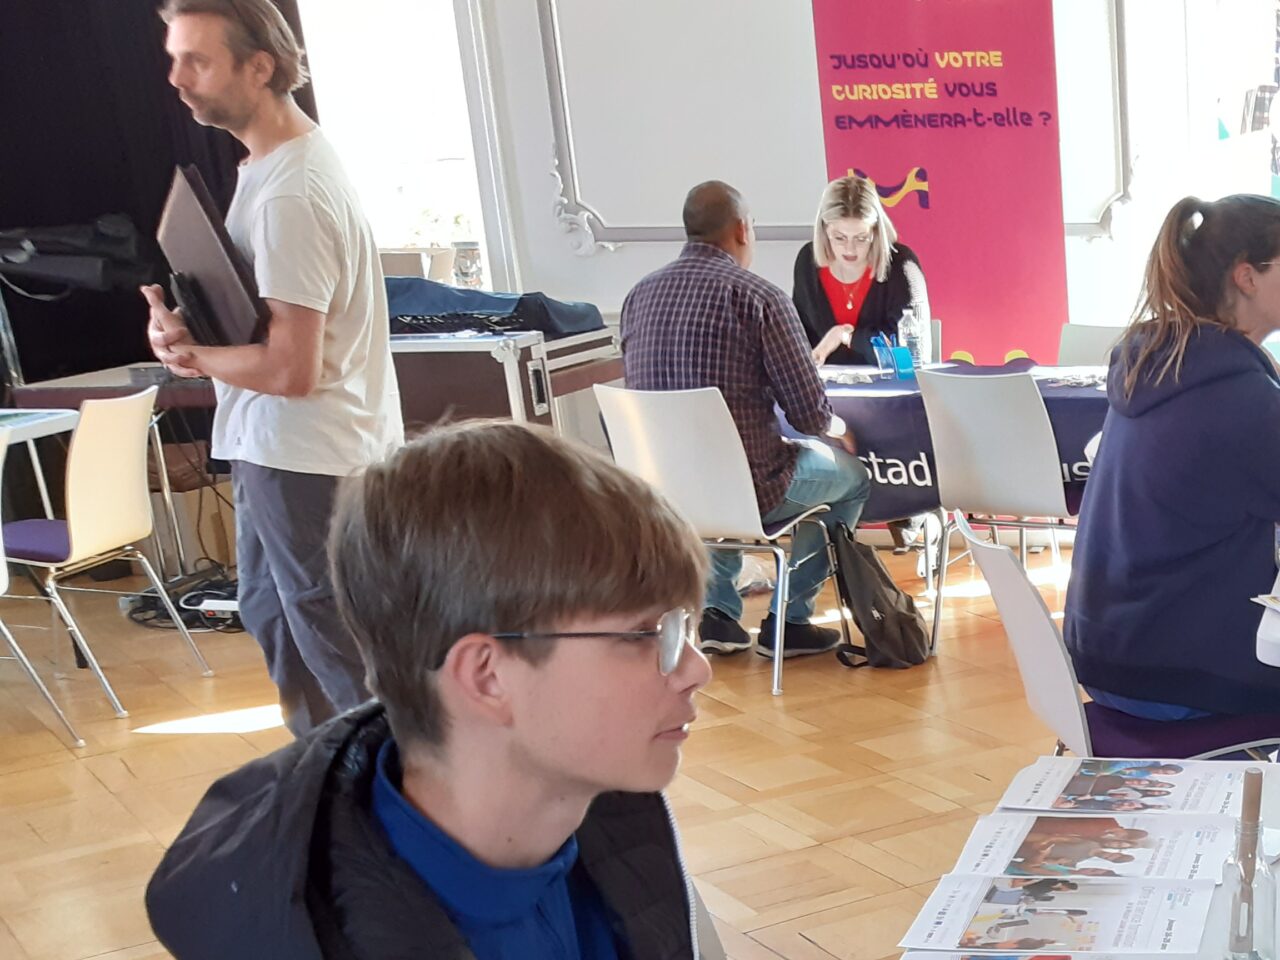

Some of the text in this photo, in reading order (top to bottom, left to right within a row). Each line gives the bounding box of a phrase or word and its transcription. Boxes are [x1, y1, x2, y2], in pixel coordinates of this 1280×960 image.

[830, 48, 1003, 70] JUSQU'OÙ VOTRE
[832, 78, 998, 101] CURIOSITÉ VOUS
[859, 451, 932, 486] stad
